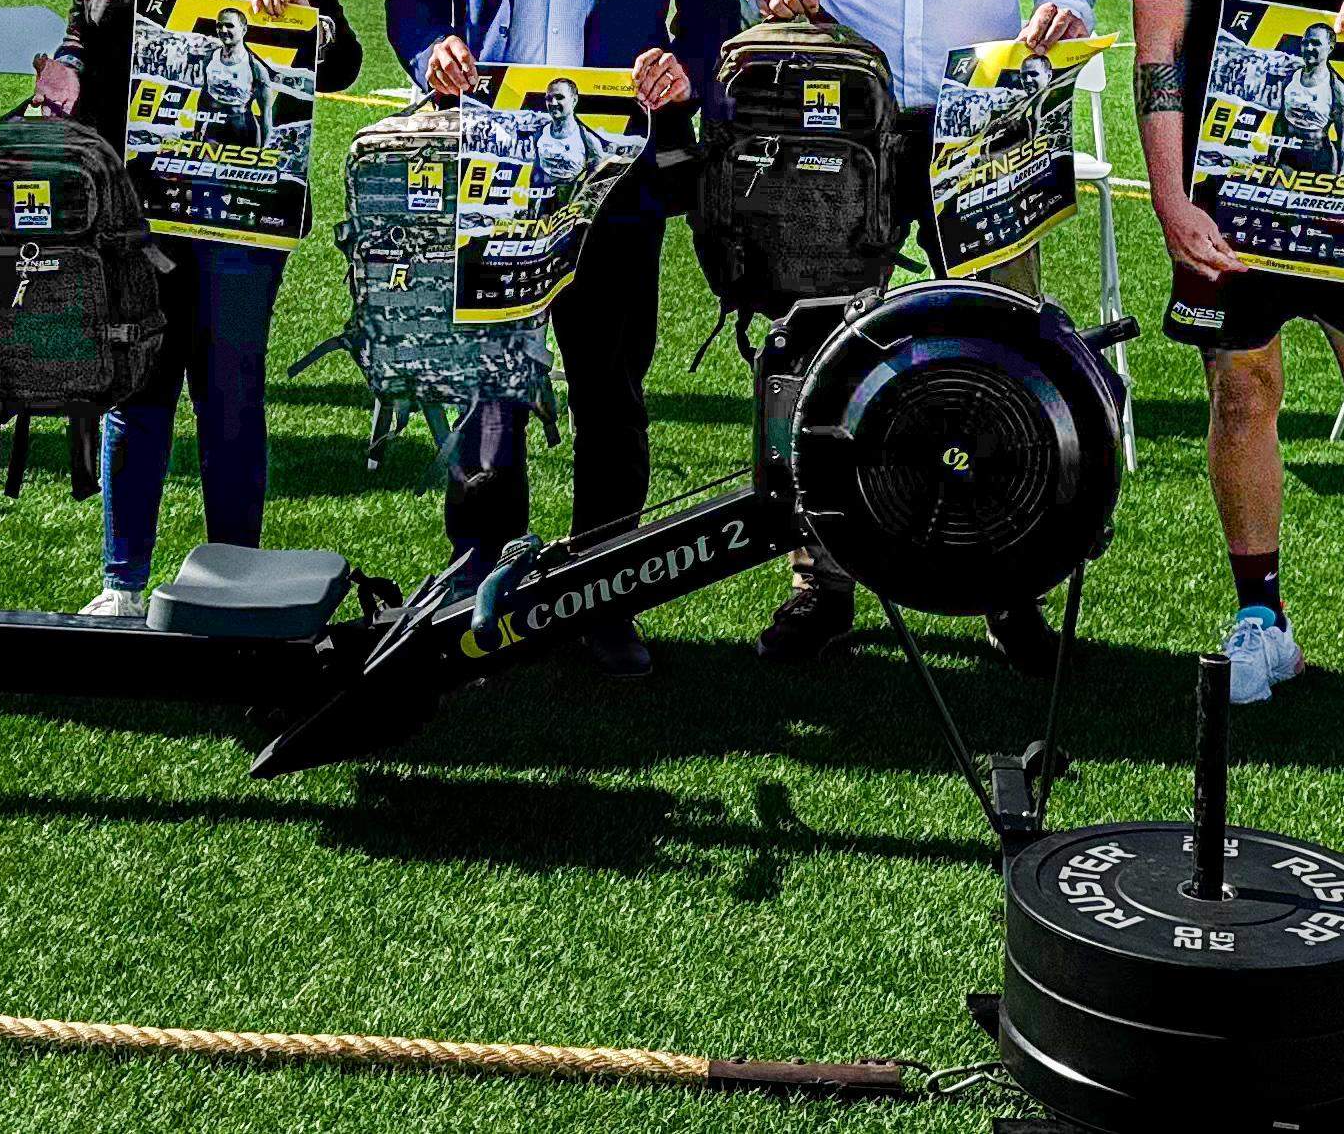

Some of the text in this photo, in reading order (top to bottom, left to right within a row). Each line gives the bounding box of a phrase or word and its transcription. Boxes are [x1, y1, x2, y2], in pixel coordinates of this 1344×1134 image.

[156, 139, 281, 167] FITNESS
[798, 155, 843, 165] FITNESS
[958, 134, 1049, 194] FITNESS
[219, 168, 275, 182] ARRECIFE
[1173, 302, 1225, 320] FITNESS
[526, 520, 750, 630] concept 2
[1173, 926, 1203, 950] 20
[1209, 931, 1235, 952] KG
